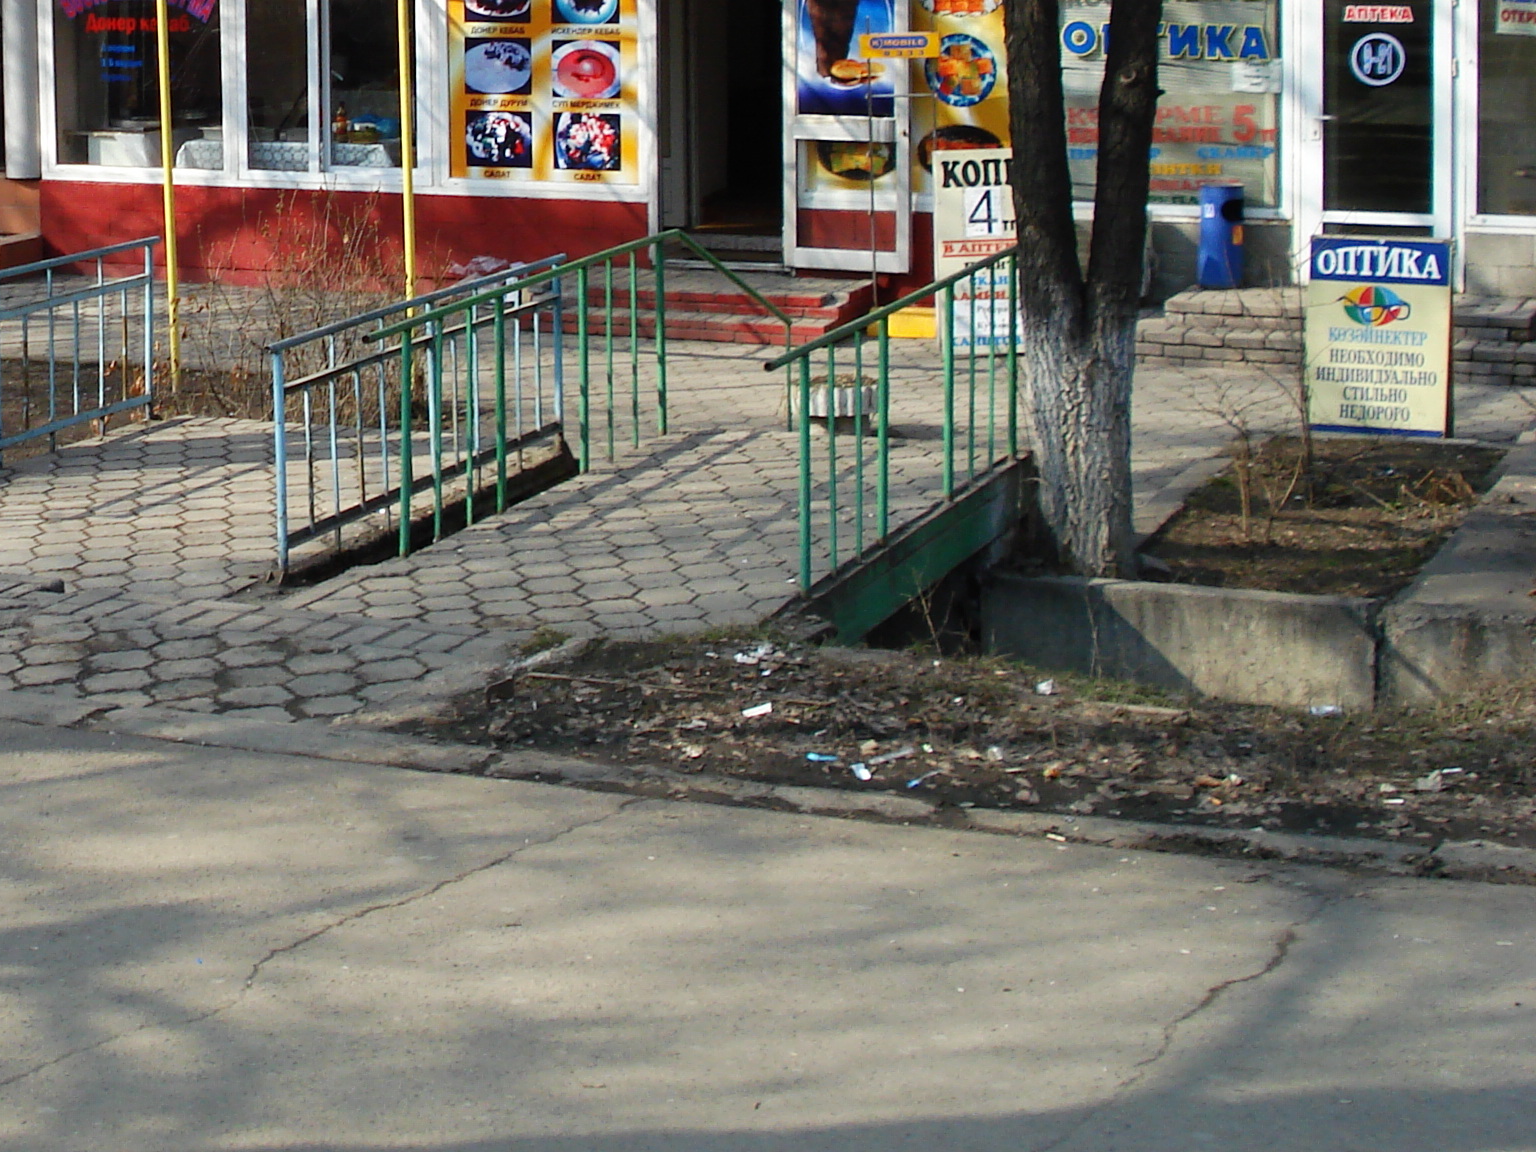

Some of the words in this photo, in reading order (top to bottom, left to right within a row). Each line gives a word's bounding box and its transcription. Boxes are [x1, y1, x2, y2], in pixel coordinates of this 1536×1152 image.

[1344, 6, 1414, 22] АПТЕКА
[85, 13, 136, 35] Донер
[140, 14, 190, 31] кеаб
[1233, 105, 1257, 143] 5
[969, 189, 998, 234] 4
[1317, 246, 1442, 280] ОПТИКА
[1330, 348, 1425, 367] НЕОБХОДИМО
[1316, 367, 1437, 386] ИНДИВИДУАЛЬНО
[1343, 386, 1407, 403] СТИЛЬНО
[1339, 404, 1410, 421] НЕДОРОГО
